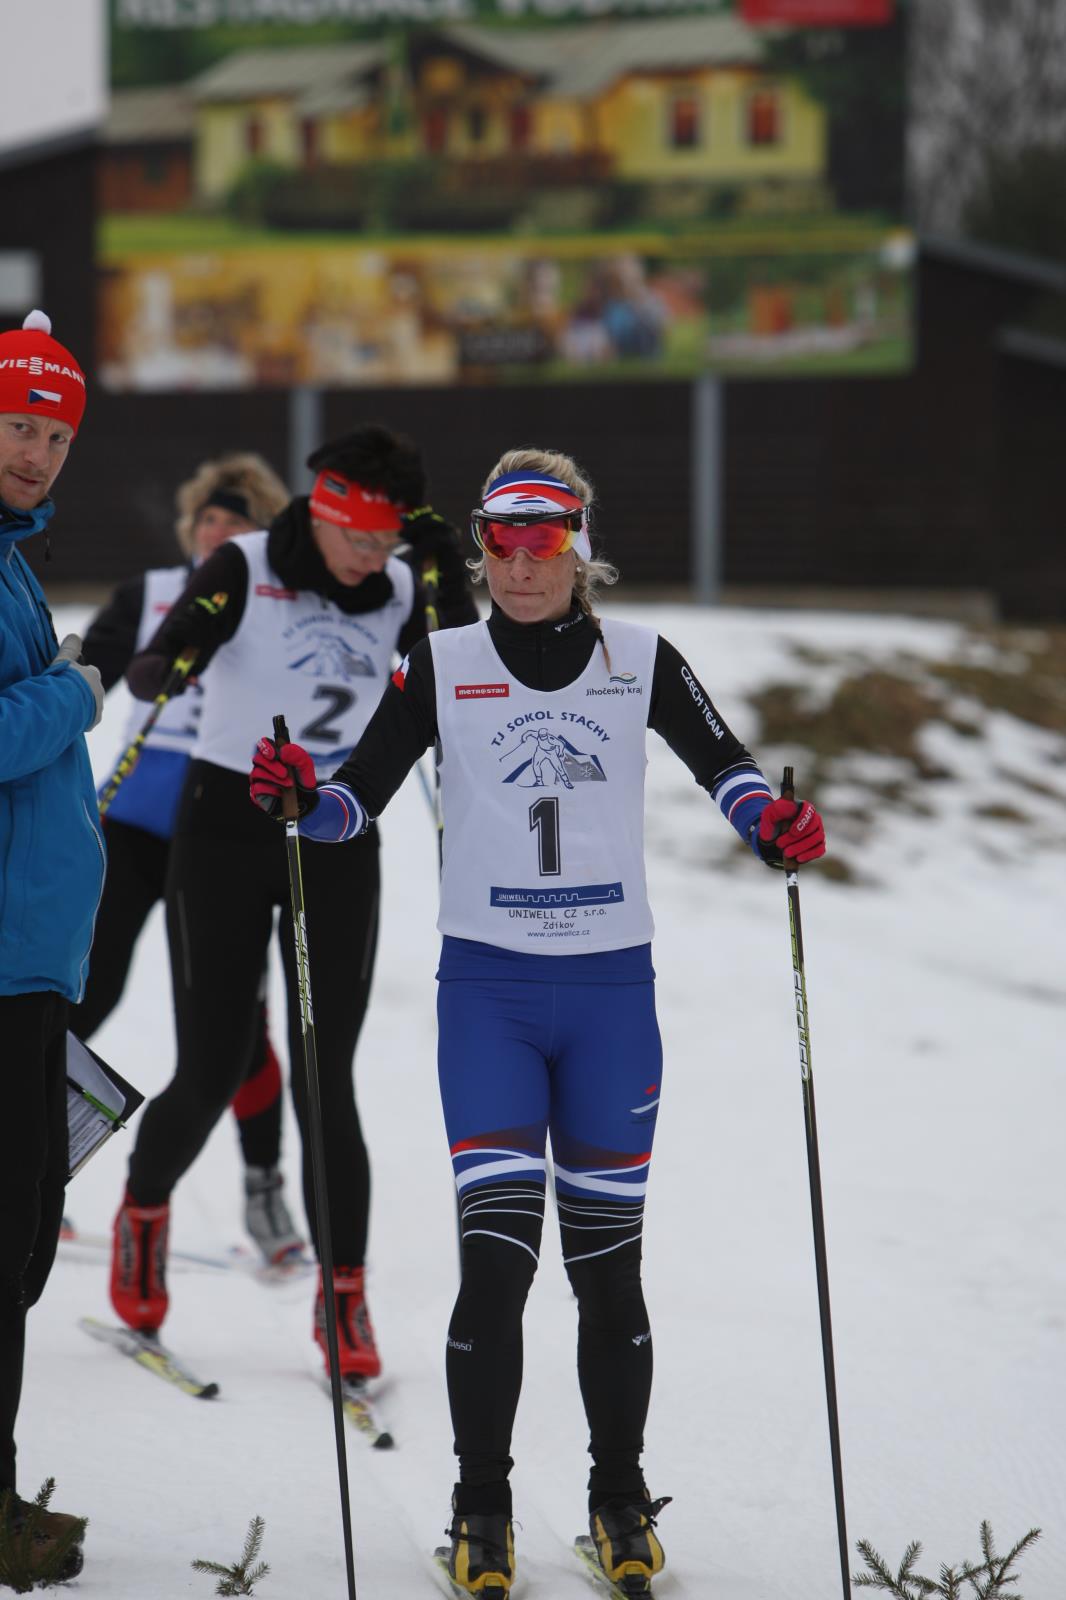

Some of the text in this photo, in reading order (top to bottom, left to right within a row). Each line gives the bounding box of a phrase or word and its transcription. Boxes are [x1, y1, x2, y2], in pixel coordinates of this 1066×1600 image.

[586, 685, 643, 697] Jihočeský kraj
[681, 665, 725, 740] CZECH TEAM
[300, 685, 358, 744] 2
[491, 710, 611, 747] TJ SOKOL STACHY
[797, 804, 815, 831] CRAFT
[528, 796, 561, 877] 1
[498, 893, 525, 901] UNIWELL
[508, 908, 607, 919] UNIWELL CZ s.r.o.
[527, 929, 591, 938] www.uniwellcz.cz
[543, 921, 575, 930] Zdíkov
